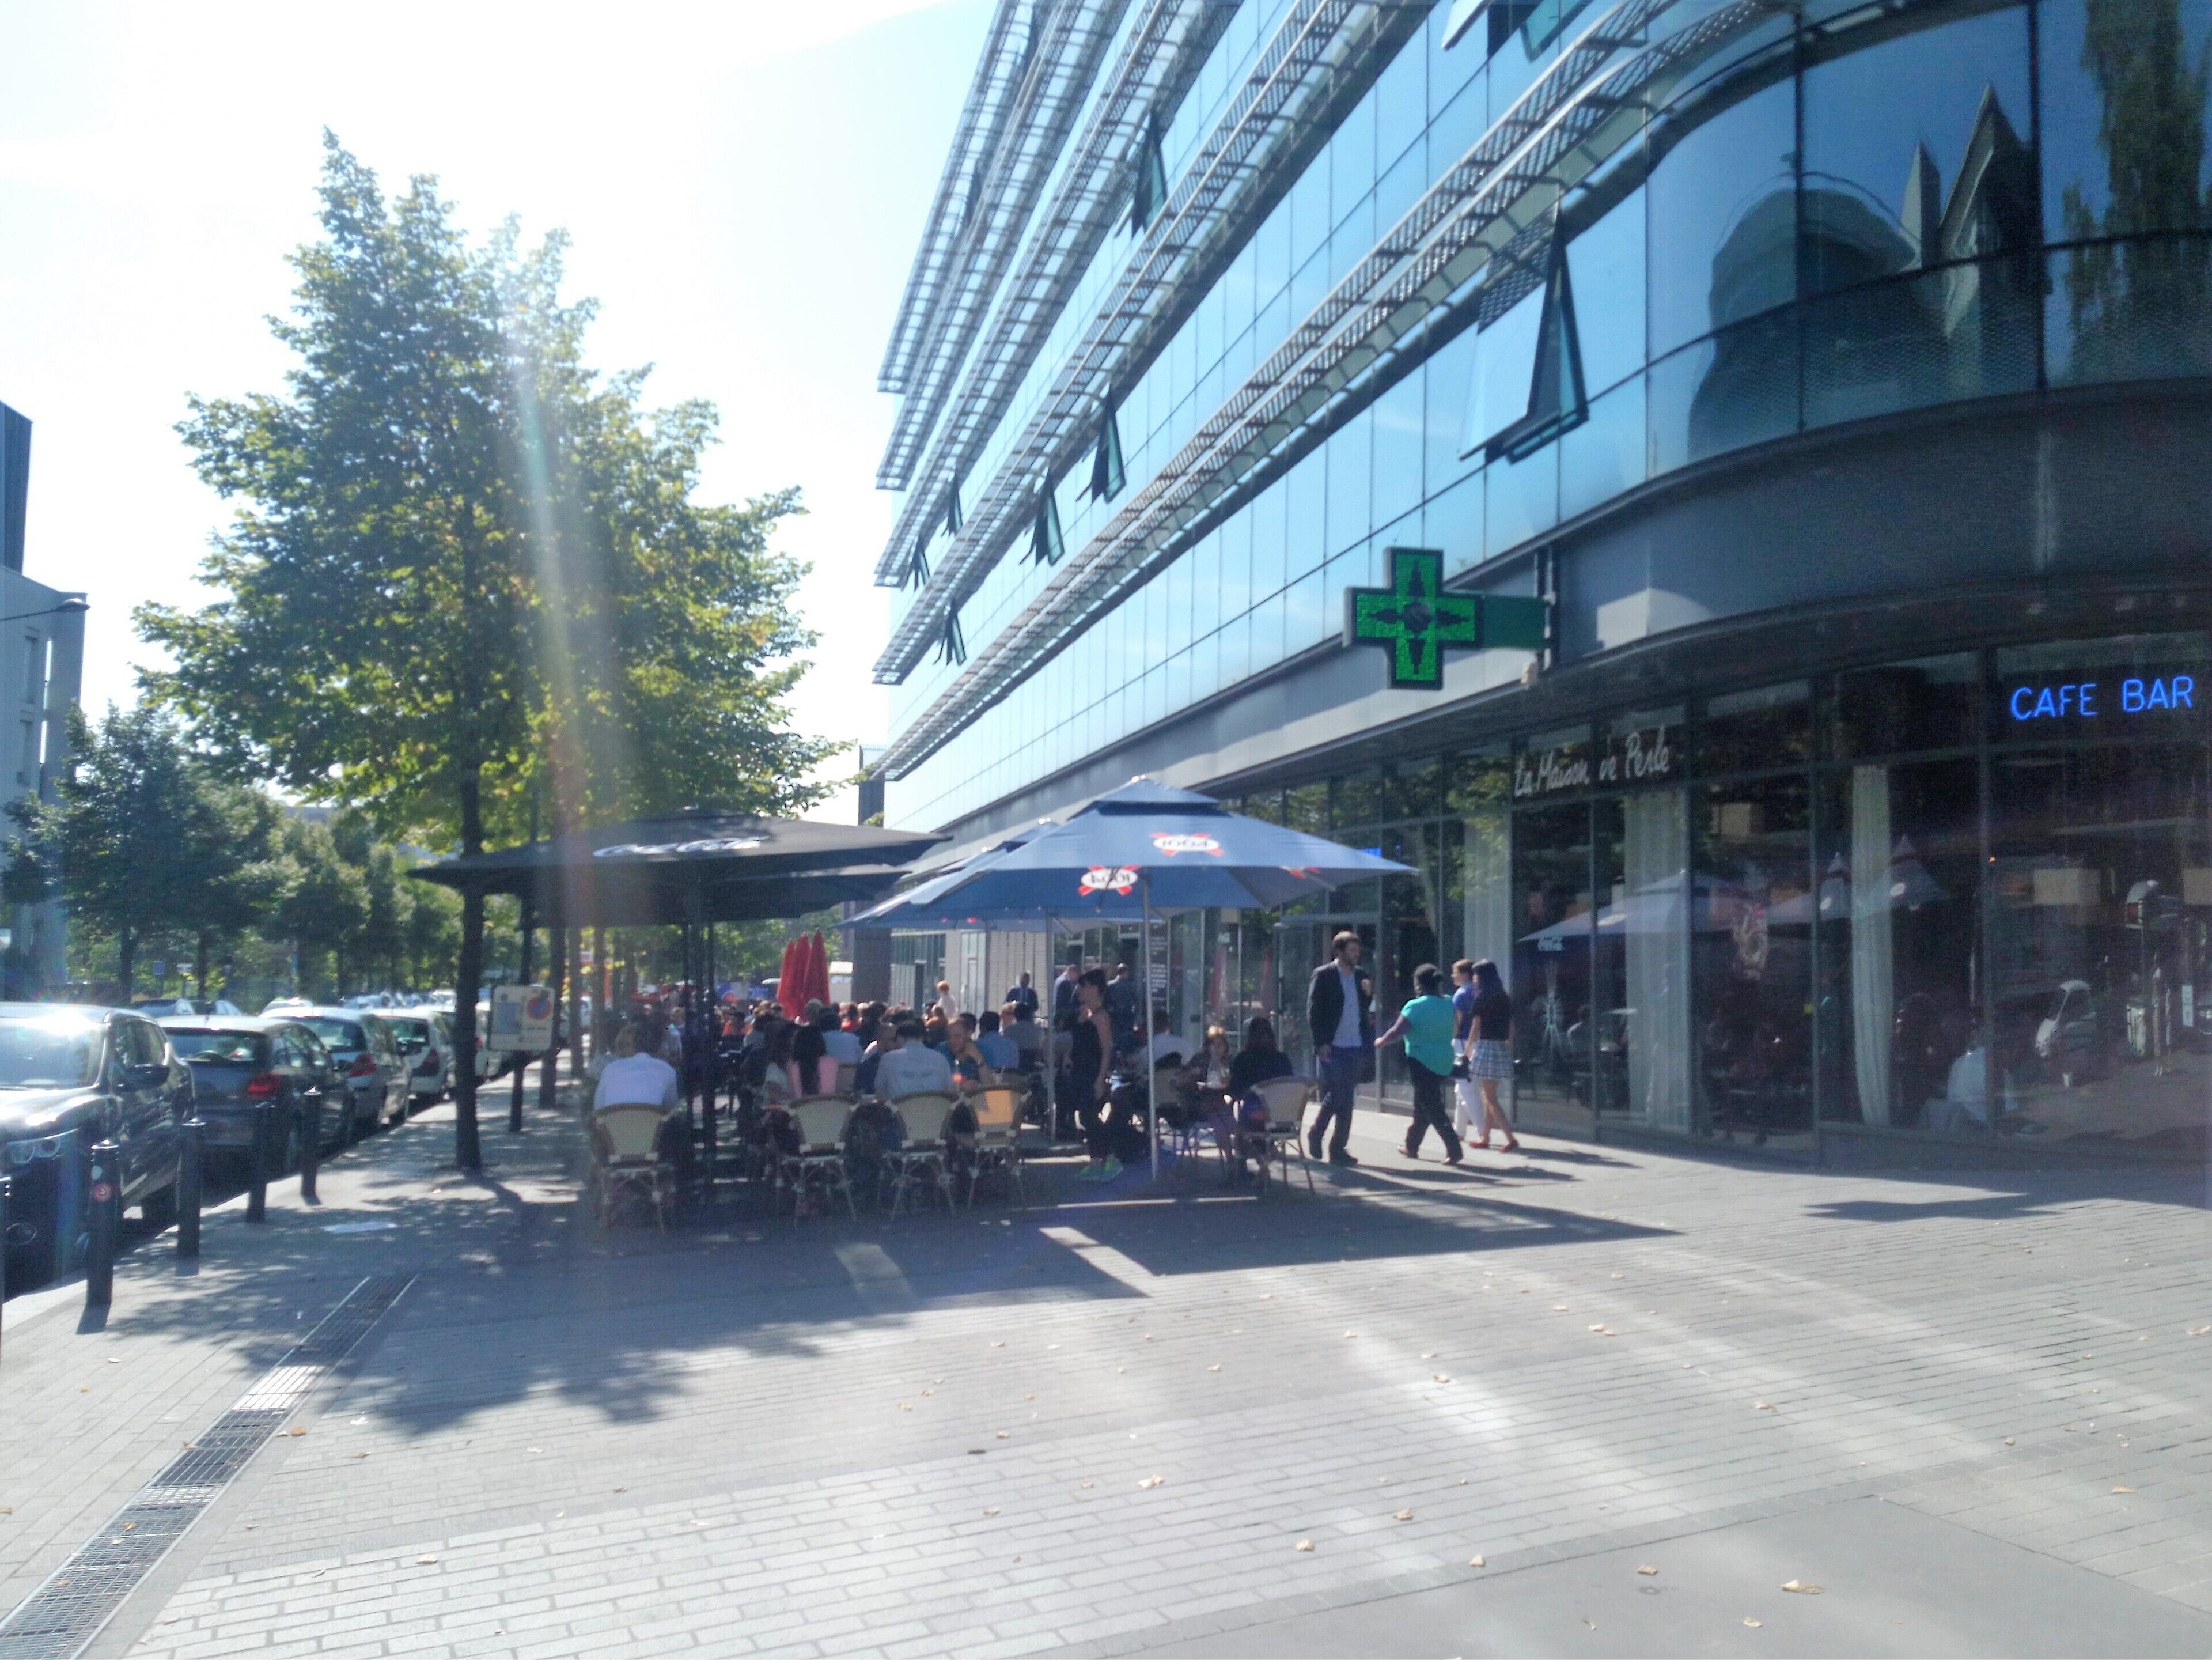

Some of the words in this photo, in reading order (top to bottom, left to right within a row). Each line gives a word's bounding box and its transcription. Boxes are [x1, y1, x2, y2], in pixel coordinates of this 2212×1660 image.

[2010, 683, 2098, 720] CAFE
[2122, 675, 2194, 712] BAR
[1514, 751, 1533, 797] La
